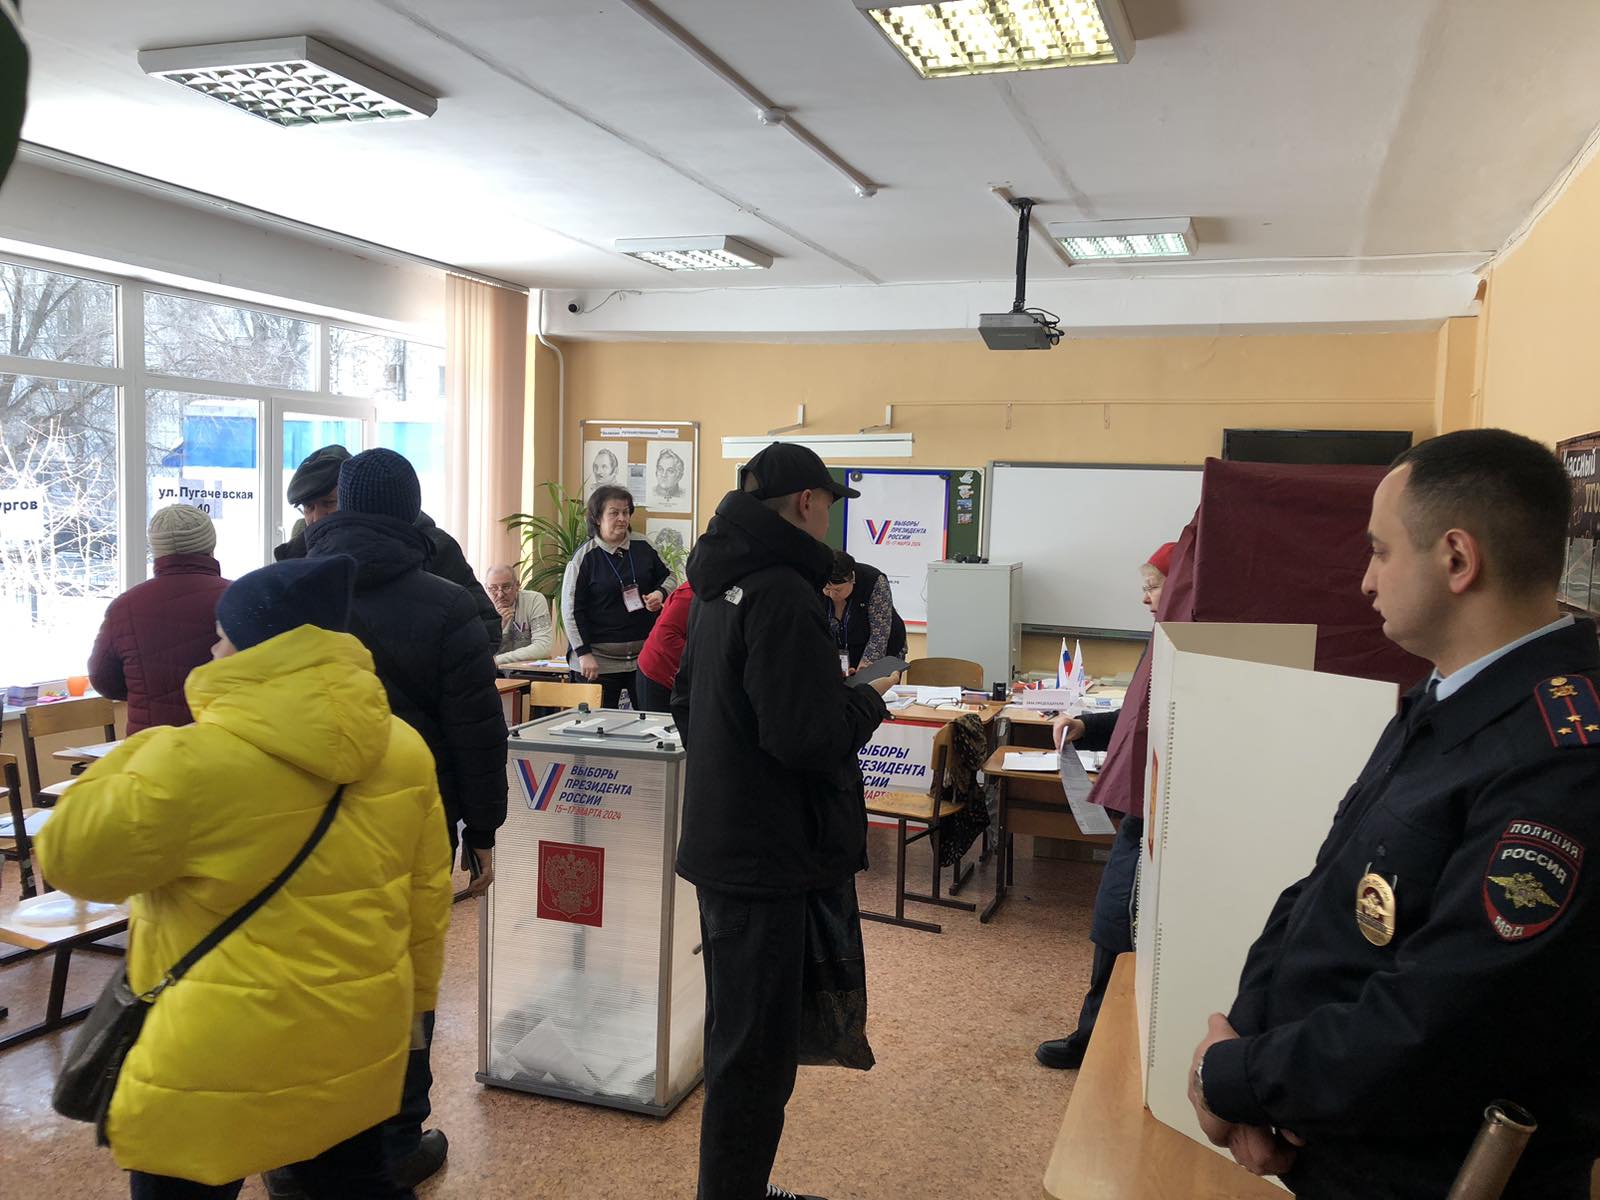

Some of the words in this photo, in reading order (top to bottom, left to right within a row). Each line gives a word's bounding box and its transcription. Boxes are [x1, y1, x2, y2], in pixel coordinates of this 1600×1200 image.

[0, 501, 38, 515] ргов
[859, 744, 910, 760] ЫБОРЫ
[570, 765, 619, 780] ВЫБОРЫ
[858, 759, 927, 777] РЕЗИДЕНТА
[564, 778, 633, 796] ПРЕЗИДЕНТА
[863, 775, 891, 788] СИИ
[558, 791, 602, 806] РОССИИ
[575, 806, 601, 819] МАРТА
[601, 809, 623, 822] 2024
[1508, 822, 1581, 860] ПОЛИЦИЯ
[1501, 848, 1568, 886] РОССИЯ
[1493, 915, 1524, 937] МВД
